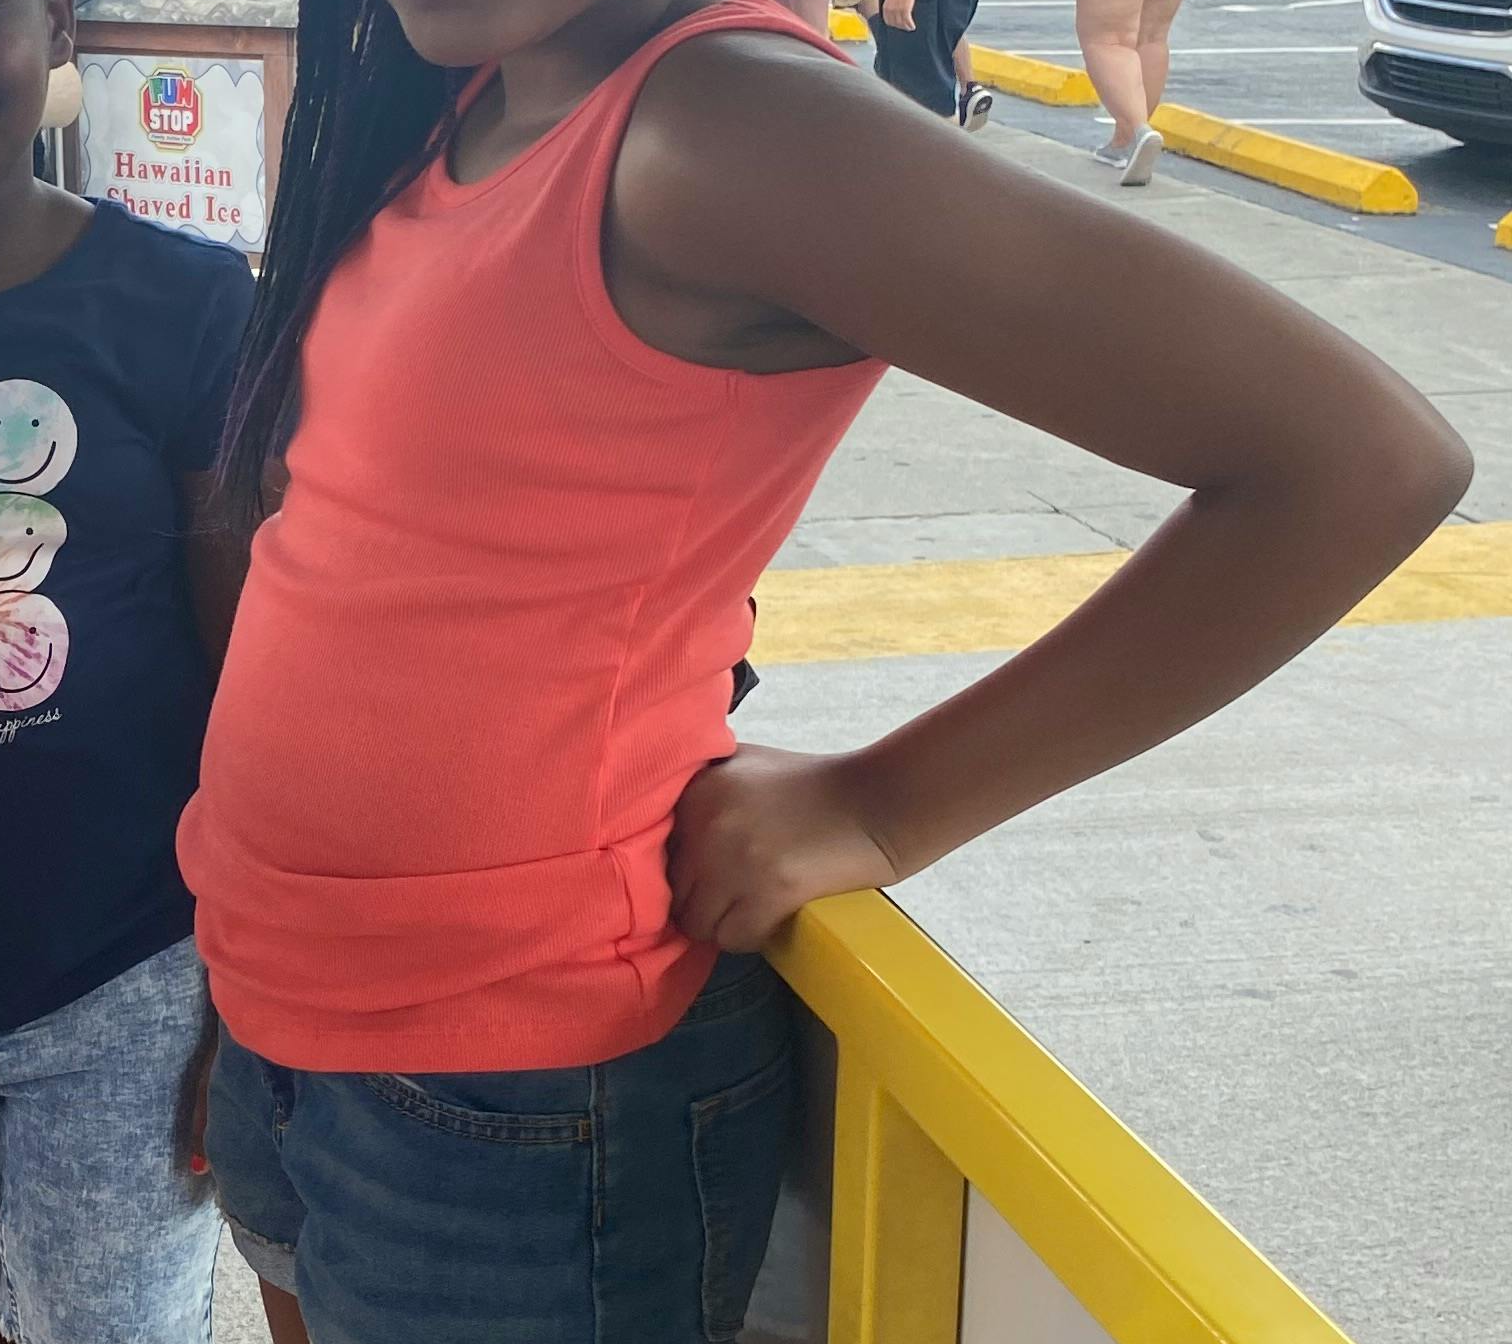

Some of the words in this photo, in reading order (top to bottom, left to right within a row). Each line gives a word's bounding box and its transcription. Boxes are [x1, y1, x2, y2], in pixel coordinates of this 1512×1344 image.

[148, 76, 195, 107] FUN
[149, 108, 194, 133] STOP
[114, 152, 232, 187] Hawaiian
[205, 195, 241, 224] Ice
